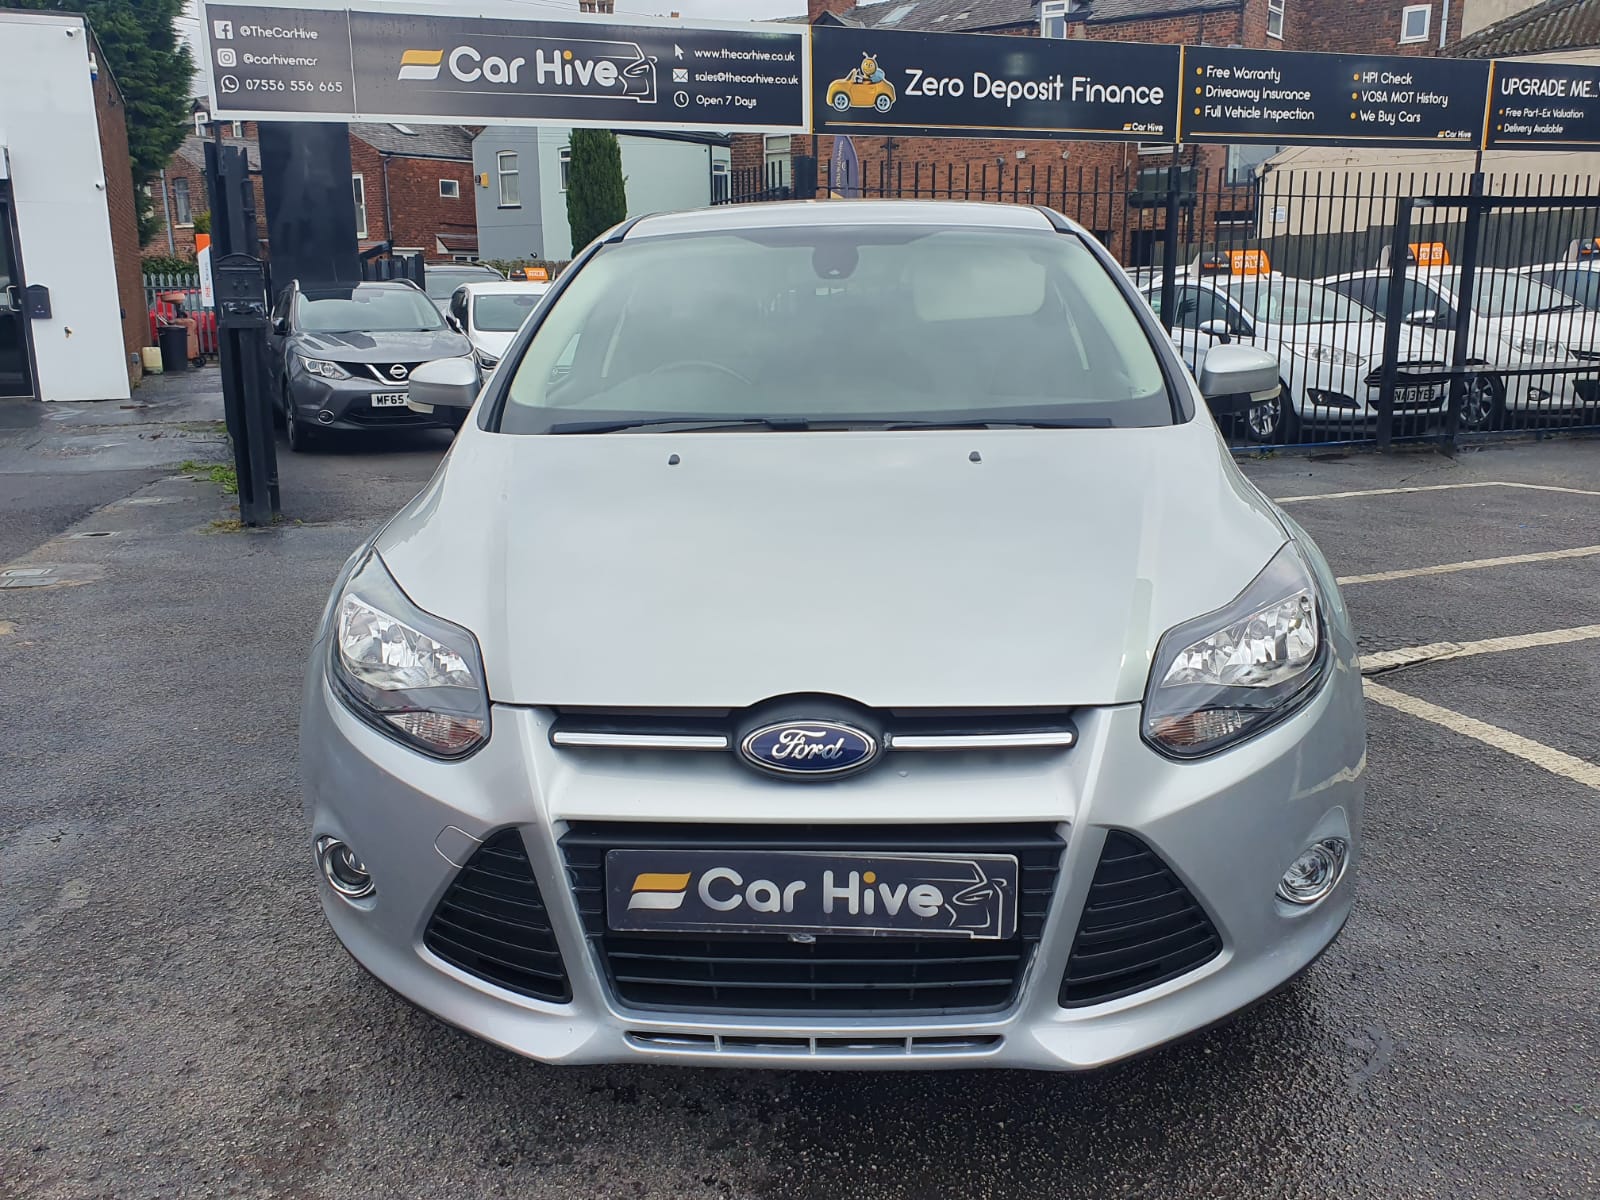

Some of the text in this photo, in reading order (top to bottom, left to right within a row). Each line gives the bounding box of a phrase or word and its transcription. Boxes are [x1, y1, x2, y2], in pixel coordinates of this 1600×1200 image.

[240, 26, 318, 39] @TheCarHive
[243, 53, 318, 66] @carhivemcr
[694, 48, 796, 61] www.thecarhive.co.uk
[449, 46, 618, 87] Car Hive
[695, 71, 799, 85] sales@thecarhive.co.uk
[1206, 65, 1281, 84] Free Warranty
[1362, 71, 1413, 85] HPI Check
[246, 79, 343, 92] 07556 556 665
[904, 69, 1165, 108] Zero Deposit Finance
[1205, 84, 1311, 102] Driveaway Insurance
[1501, 78, 1567, 97] UPGRADE
[696, 94, 757, 109] Open 7 Days
[1361, 90, 1449, 108] VOSA MOT History
[1204, 105, 1315, 122] Full Vehicle Inspection
[1359, 109, 1421, 126] We Buy Cars
[1505, 107, 1522, 118] Free
[1552, 109, 1584, 119] Valuation
[1132, 122, 1164, 132] Car Hive
[1503, 123, 1533, 135] Delivery
[376, 394, 404, 405] MF65
[771, 729, 845, 760] Ford
[698, 866, 944, 918] Car Hive
